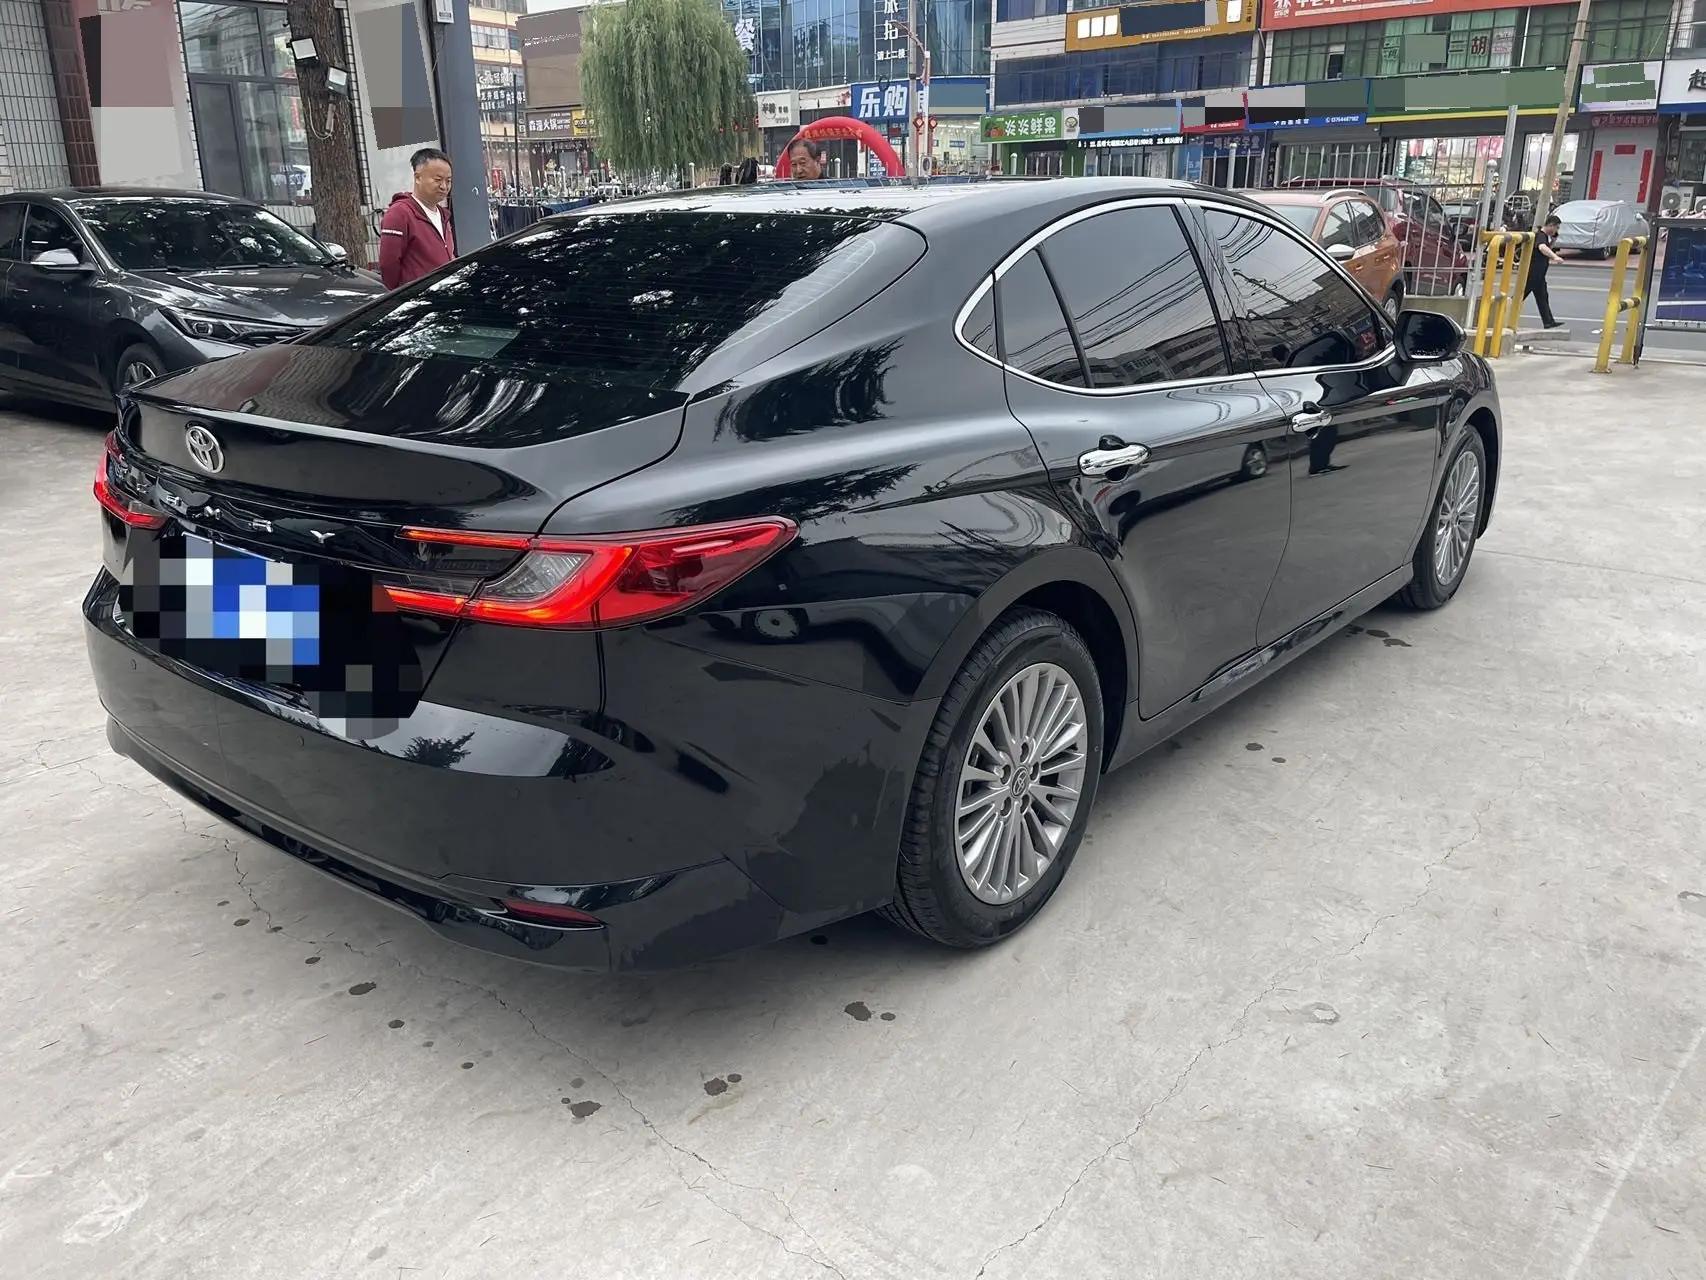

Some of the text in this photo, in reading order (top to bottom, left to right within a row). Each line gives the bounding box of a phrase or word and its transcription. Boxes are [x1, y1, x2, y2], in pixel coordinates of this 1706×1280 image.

[735, 18, 755, 52] 餐
[1449, 36, 1489, 55] 二胡
[859, 84, 908, 119] 乐购
